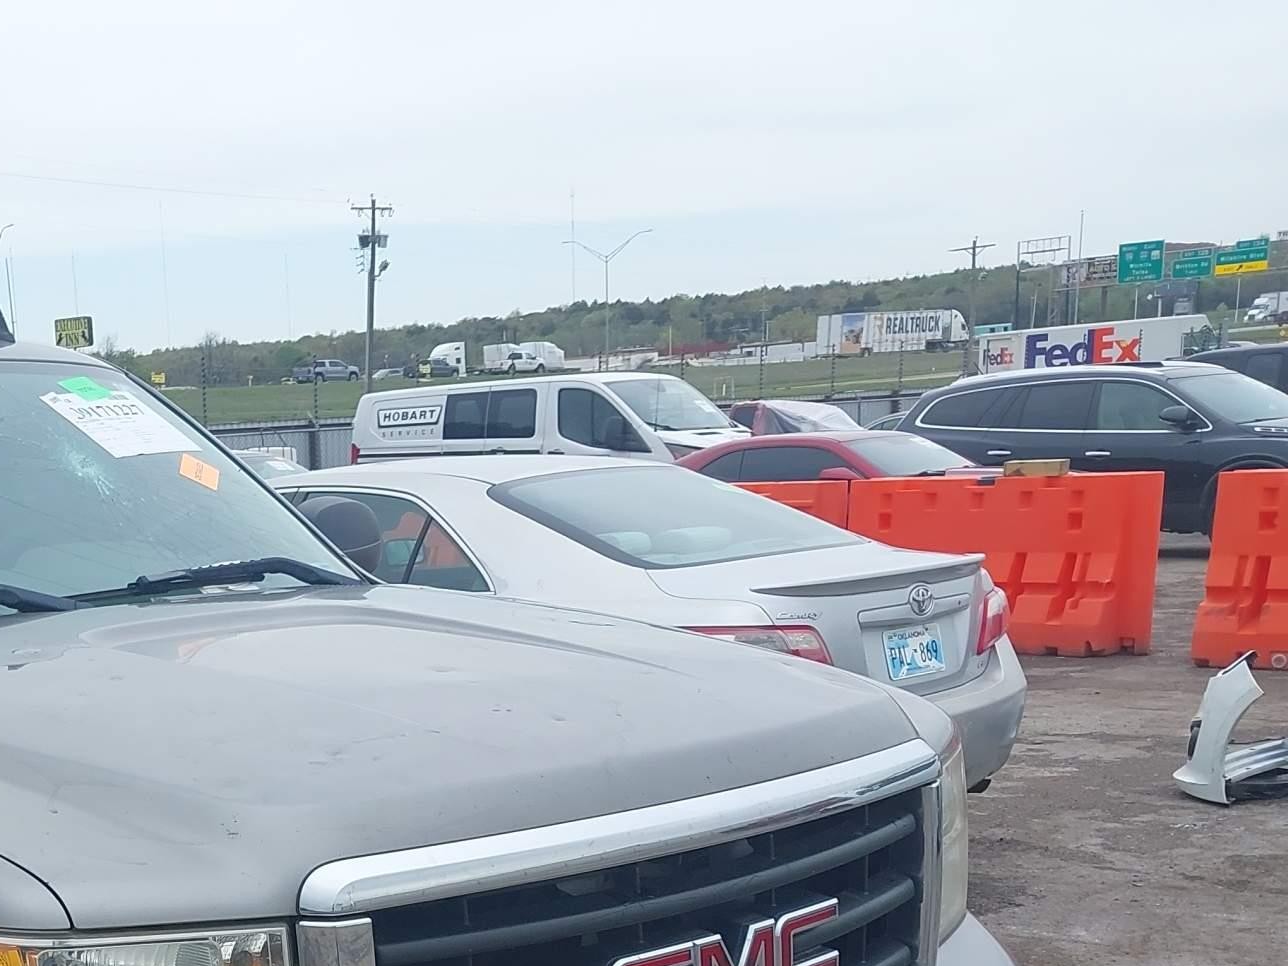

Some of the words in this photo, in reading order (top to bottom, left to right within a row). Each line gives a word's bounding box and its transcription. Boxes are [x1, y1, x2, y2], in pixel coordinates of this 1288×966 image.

[886, 315, 940, 335] REALTRUCK
[983, 347, 1014, 366] FedEx
[1024, 327, 1141, 368] FedEx
[383, 410, 436, 422] HOBART
[382, 428, 435, 437] SERVICE
[918, 639, 938, 663] 869
